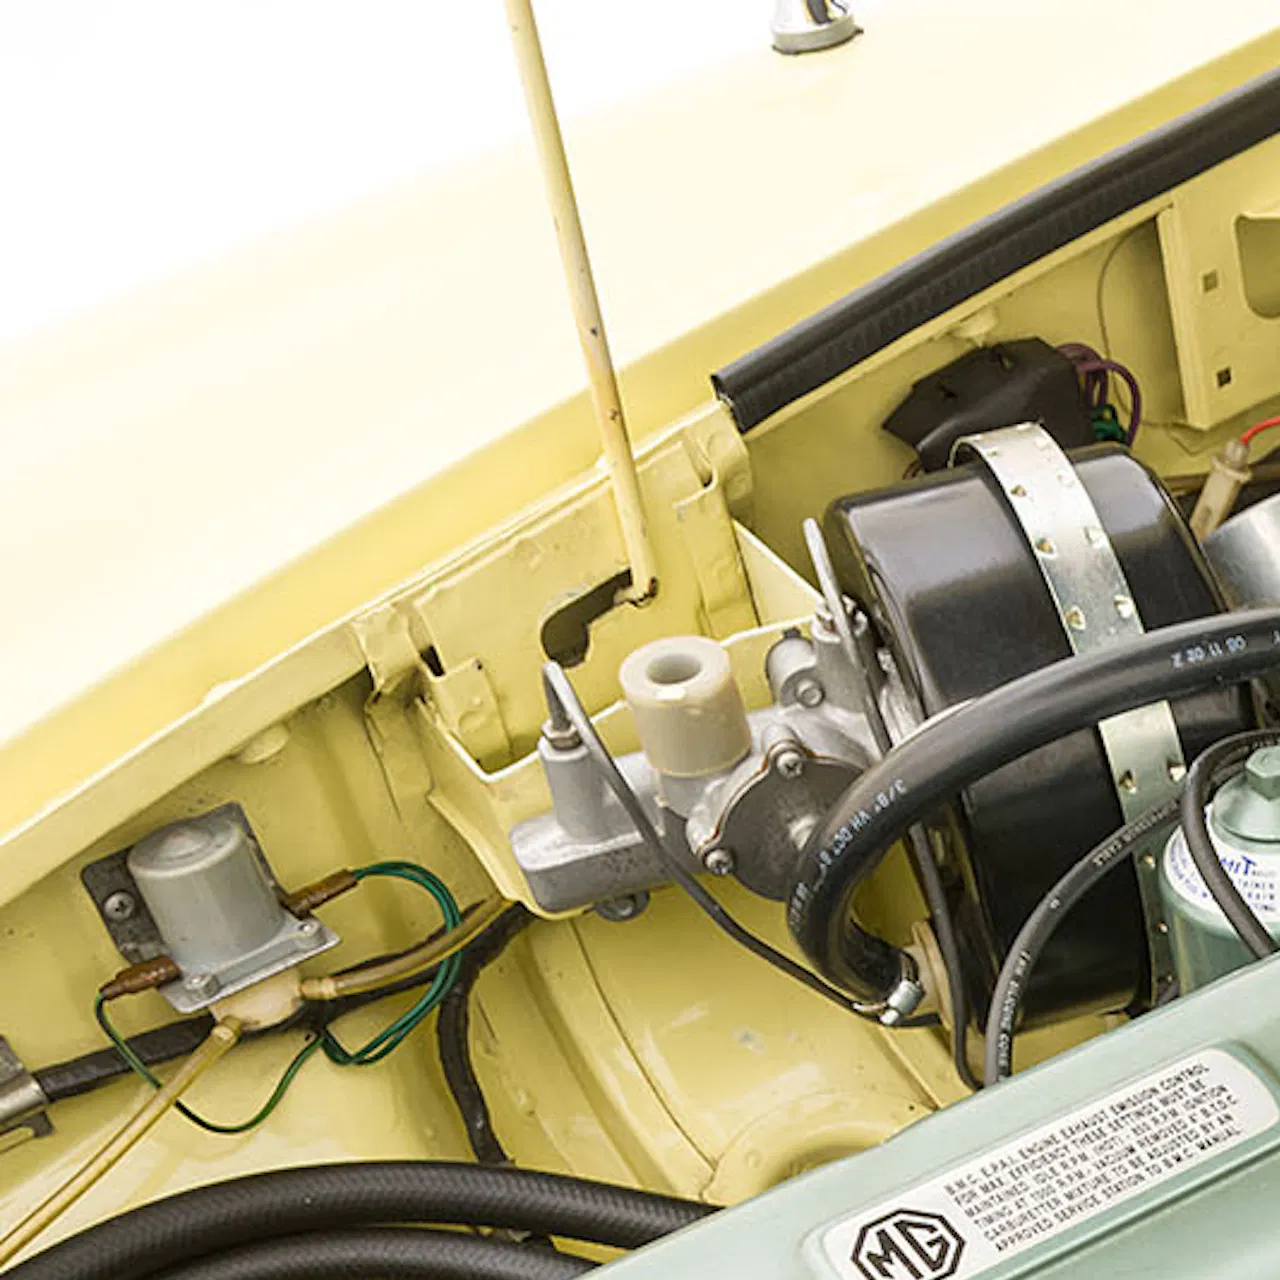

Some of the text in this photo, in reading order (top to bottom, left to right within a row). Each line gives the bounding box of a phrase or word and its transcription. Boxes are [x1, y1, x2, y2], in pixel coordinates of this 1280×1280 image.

[1007, 1144, 1071, 1181] EFFICIENCY
[1071, 1126, 1107, 1147] THESE
[1107, 1102, 1159, 1132] SETTINGS
[1188, 1078, 1206, 1093] BE
[1018, 1134, 1060, 1160] ENGINE
[1060, 1109, 1108, 1140] EXHAUST
[1109, 1087, 1160, 1116] EMISSION
[1159, 1064, 1210, 1091] CONTROL
[1183, 1084, 1228, 1111] IGNITION
[983, 1113, 1233, 1241] CARBURETTER MIXTURE TO BE ADJUSTED BY AN
[1093, 1145, 1136, 1170] VACUUM
[1136, 1118, 1188, 1148] REMOVED
[867, 1219, 951, 1280] MG
[995, 1218, 1054, 1252] APPROVED
[1053, 1194, 1101, 1223] SERVICE
[1101, 1173, 1146, 1199] STATION
[1144, 1163, 1162, 1176] TO
